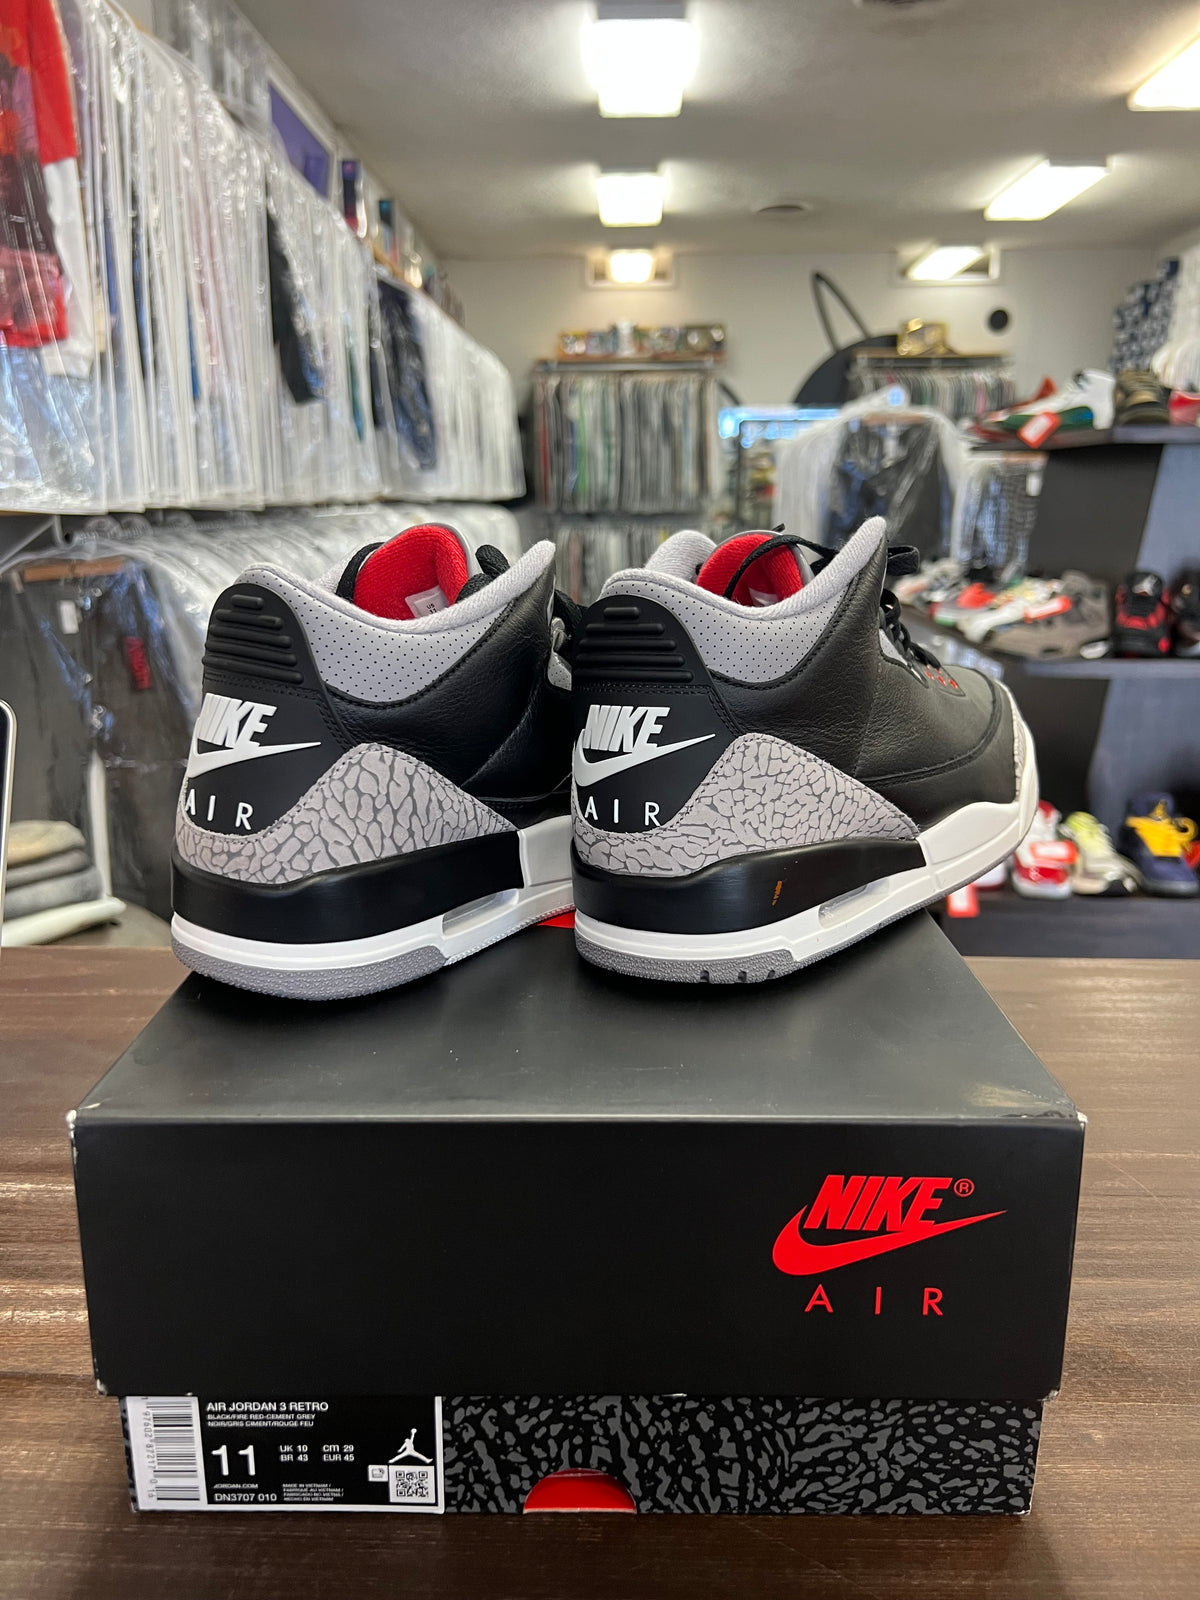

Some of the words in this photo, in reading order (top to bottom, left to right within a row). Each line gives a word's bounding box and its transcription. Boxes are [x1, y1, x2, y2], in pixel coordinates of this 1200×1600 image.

[196, 692, 278, 748] NIKE
[582, 704, 671, 753] NIKE
[185, 788, 254, 831] AIR
[584, 796, 661, 827] AIR
[804, 1283, 944, 1317] AIR
[206, 1402, 227, 1411] AIR
[229, 1402, 277, 1411] JORDAN
[279, 1402, 287, 1411] 3
[289, 1402, 329, 1411] RETRO
[279, 1444, 293, 1453] UK
[297, 1444, 309, 1453] 10
[280, 1454, 294, 1462] BR
[297, 1454, 309, 1462] 43
[323, 1454, 342, 1462] EUR
[343, 1454, 355, 1462] 45
[343, 1444, 355, 1453] 29
[211, 1444, 256, 1476] 11
[214, 1493, 256, 1501] DN3707
[258, 1493, 278, 1501] 010
